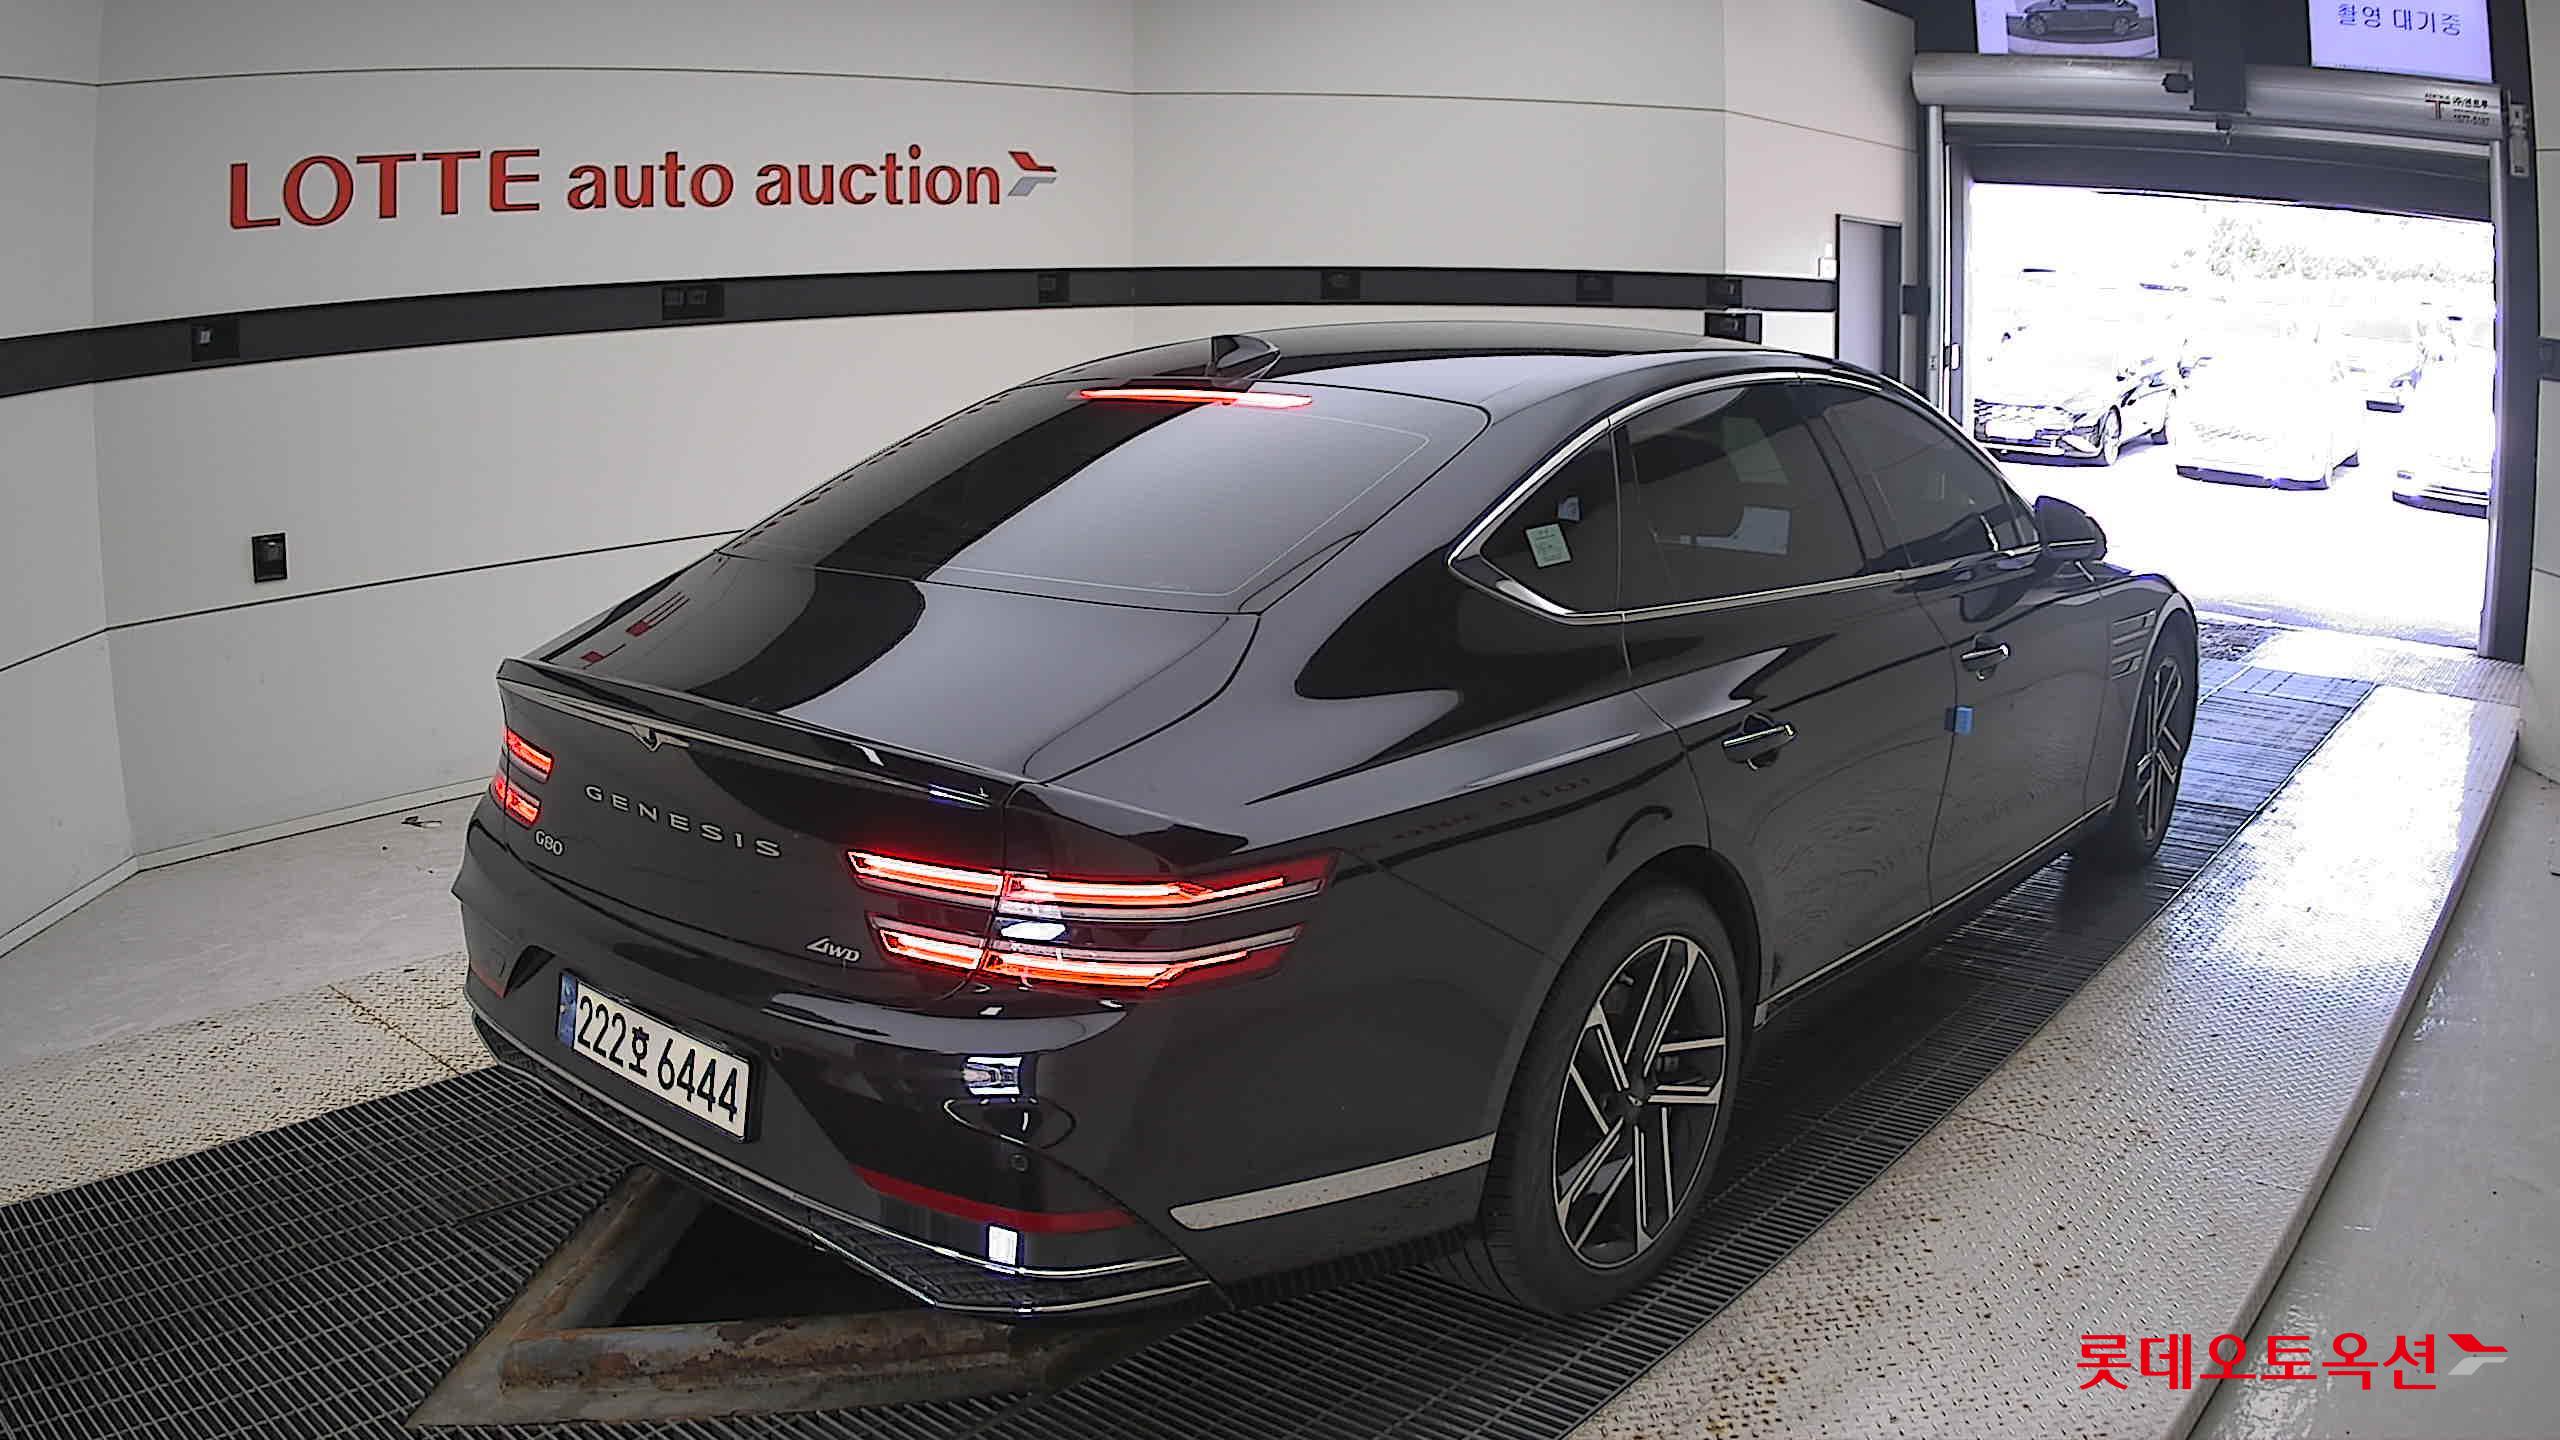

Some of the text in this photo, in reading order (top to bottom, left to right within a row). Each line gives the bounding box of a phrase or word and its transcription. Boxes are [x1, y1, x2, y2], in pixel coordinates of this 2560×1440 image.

[2337, 3, 2461, 36] 촬영 대기중
[229, 144, 1001, 230] LOTTE auto auction
[535, 829, 564, 856] G80
[583, 784, 783, 858] GENESIS
[806, 937, 861, 962] 4WD
[576, 995, 739, 1123] 222호 6444
